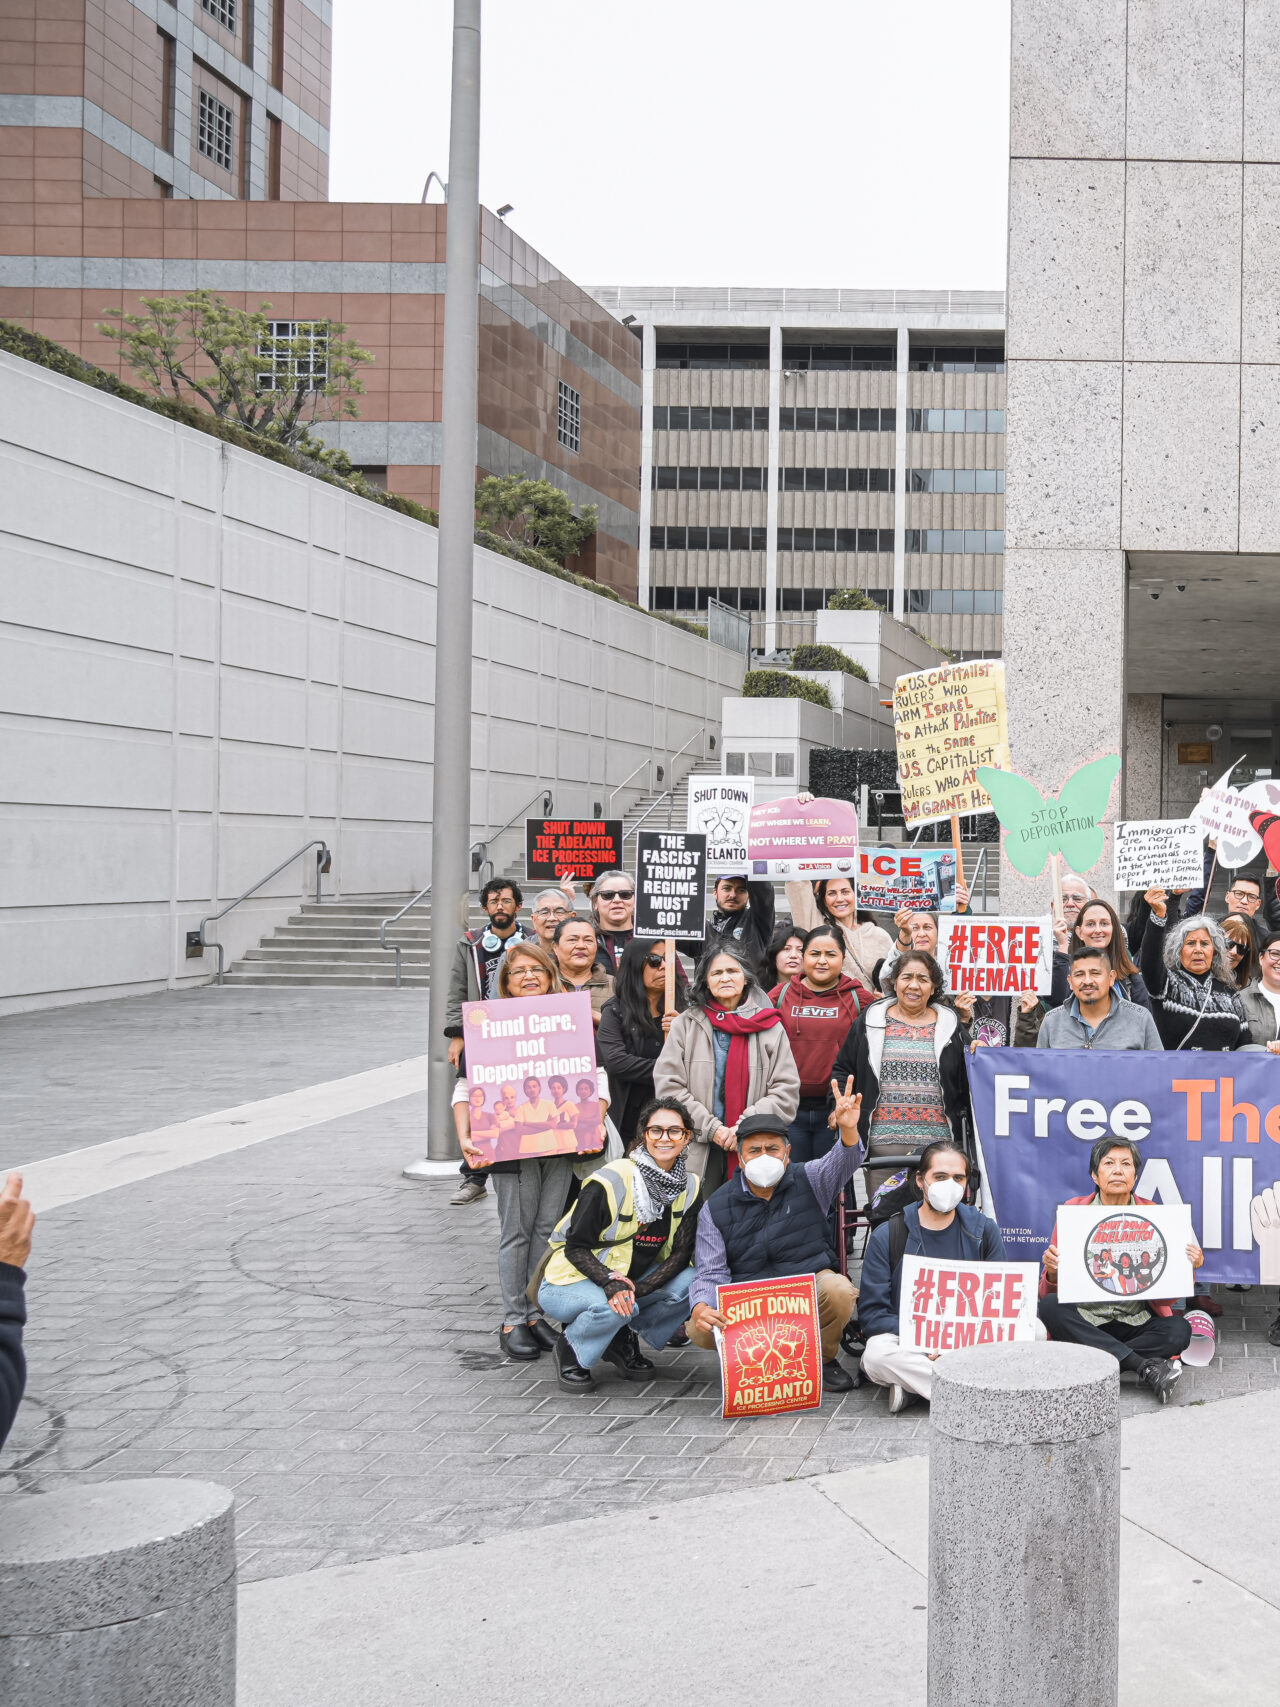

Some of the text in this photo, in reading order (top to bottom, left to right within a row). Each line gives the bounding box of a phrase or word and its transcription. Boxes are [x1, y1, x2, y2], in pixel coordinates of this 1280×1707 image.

[909, 675, 927, 690] U.S.
[943, 684, 968, 696] WHO
[894, 696, 973, 722] ARM ISRAEL
[900, 761, 923, 780] U.S.
[935, 776, 960, 793] WHO
[694, 788, 748, 804] SHUT DOWN
[1209, 789, 1258, 811] IGRATION
[1031, 806, 1068, 823] STOP
[1213, 805, 1219, 813] IS
[543, 822, 606, 835] SHUT DOWN
[1021, 816, 1094, 842] DEPORTATION
[1116, 822, 1197, 840] Immigrants
[1200, 816, 1248, 838] UMAN RIGHT
[536, 836, 613, 849] THE ADELANTO
[658, 836, 685, 849] THE
[750, 836, 856, 846] NOT WHERE WE PRAY!
[1120, 841, 1181, 854] criminals
[532, 850, 616, 863] ICE PROCESSING
[642, 850, 700, 865] FASCIST
[707, 848, 746, 860] ELANTO
[1116, 855, 1134, 863] The
[554, 864, 594, 877] CENTER
[646, 865, 696, 880] TRUMP
[860, 854, 922, 877] ICE
[644, 880, 698, 896] REGIME
[1126, 879, 1152, 887] Trump
[650, 897, 690, 910] MUST
[860, 897, 932, 908] LITTLE TOKYO
[657, 912, 681, 926] GO!
[637, 927, 702, 938] RefuseFascism.org
[948, 925, 1040, 964] #FREE
[949, 964, 1038, 991] THEMALL
[481, 1014, 576, 1038] Fund Care,
[516, 1037, 546, 1057] not
[472, 1056, 592, 1085] Deportations
[994, 1074, 1152, 1141] Free
[1099, 1221, 1150, 1231] SHUT DOWN
[1092, 1229, 1155, 1243] ADELANTO!
[912, 1268, 1023, 1318] #FREE
[727, 1296, 810, 1325] SHUT DOWN
[733, 1380, 813, 1406] ADELANTO
[748, 1400, 785, 1410] PROCESSING
[786, 1396, 807, 1404] CENTER
